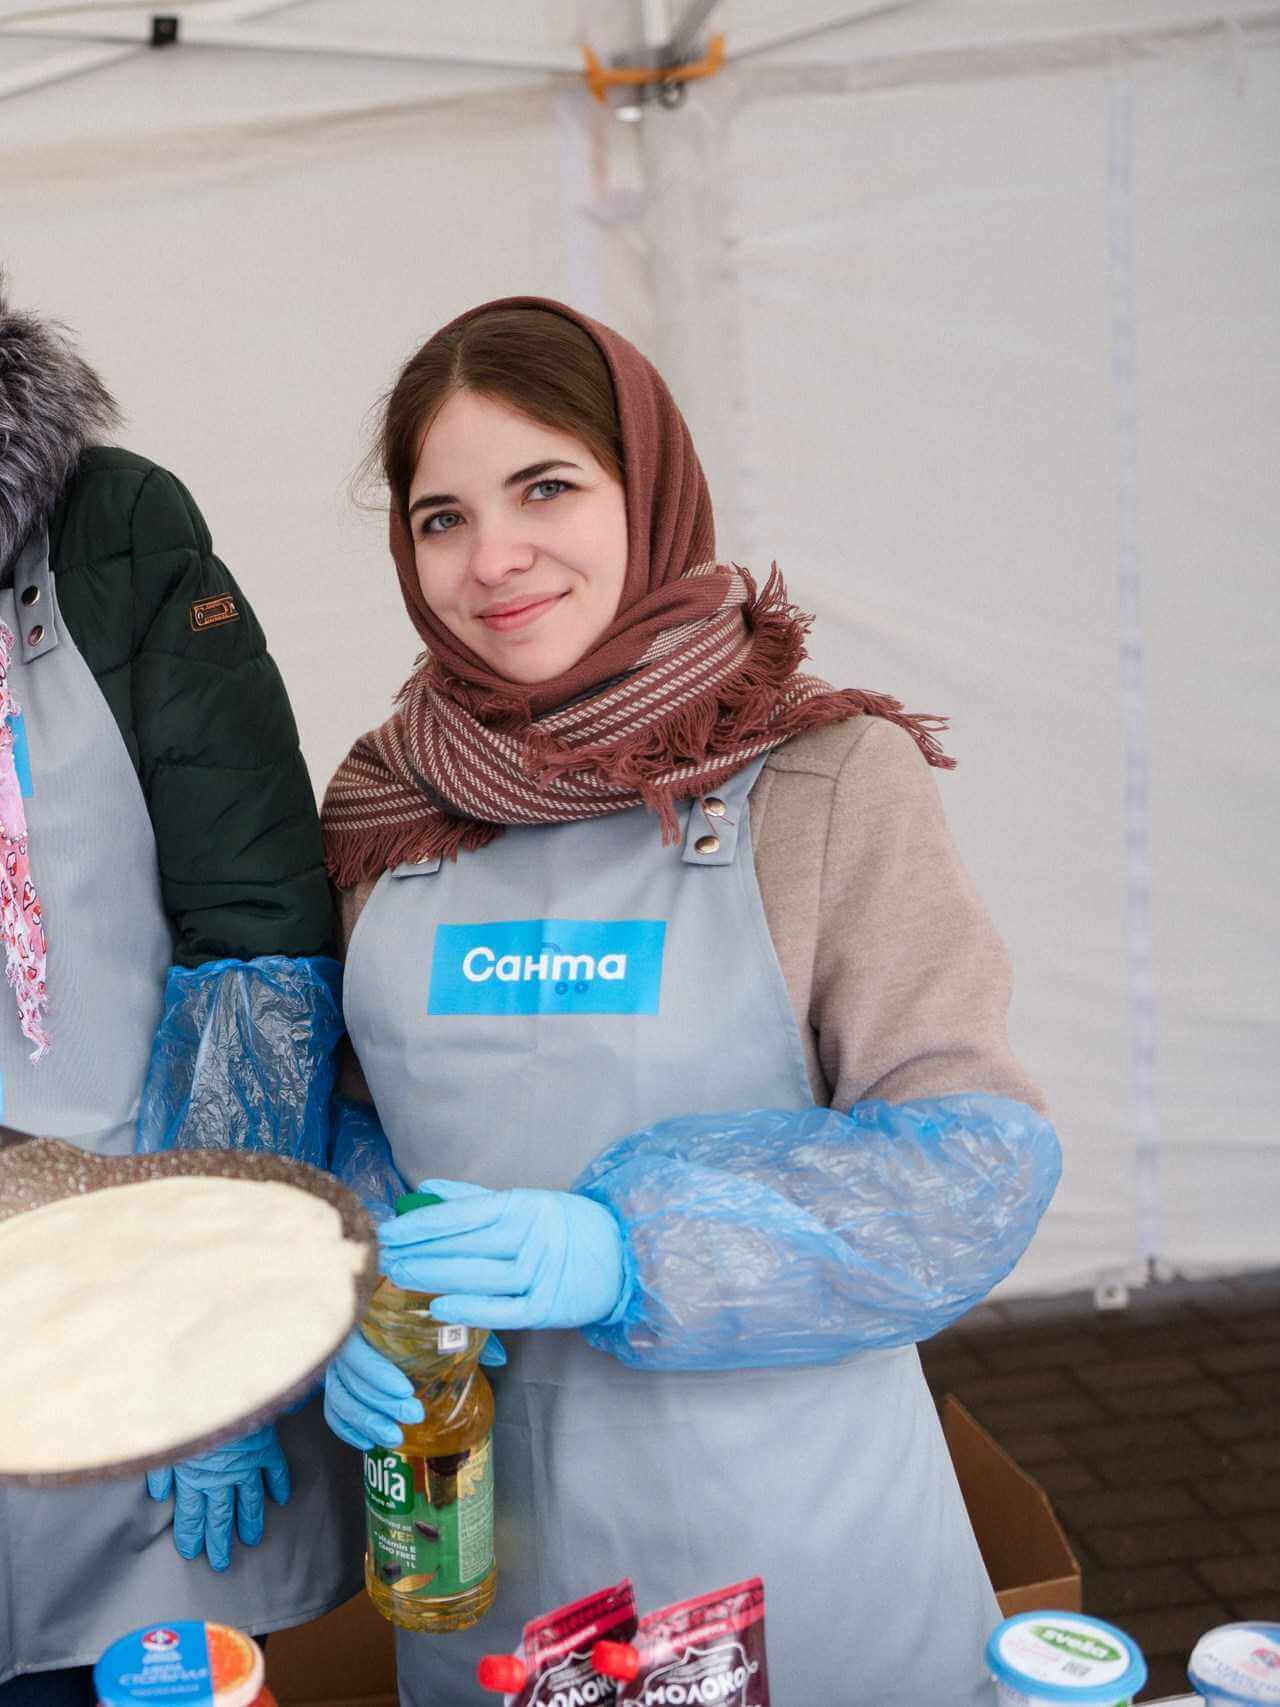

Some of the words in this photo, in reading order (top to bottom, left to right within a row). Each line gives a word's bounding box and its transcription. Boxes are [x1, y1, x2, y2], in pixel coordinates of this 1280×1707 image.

[462, 946, 628, 983] Санта
[395, 1550, 417, 1561] FREE
[645, 1666, 746, 1706] МОЛОКО
